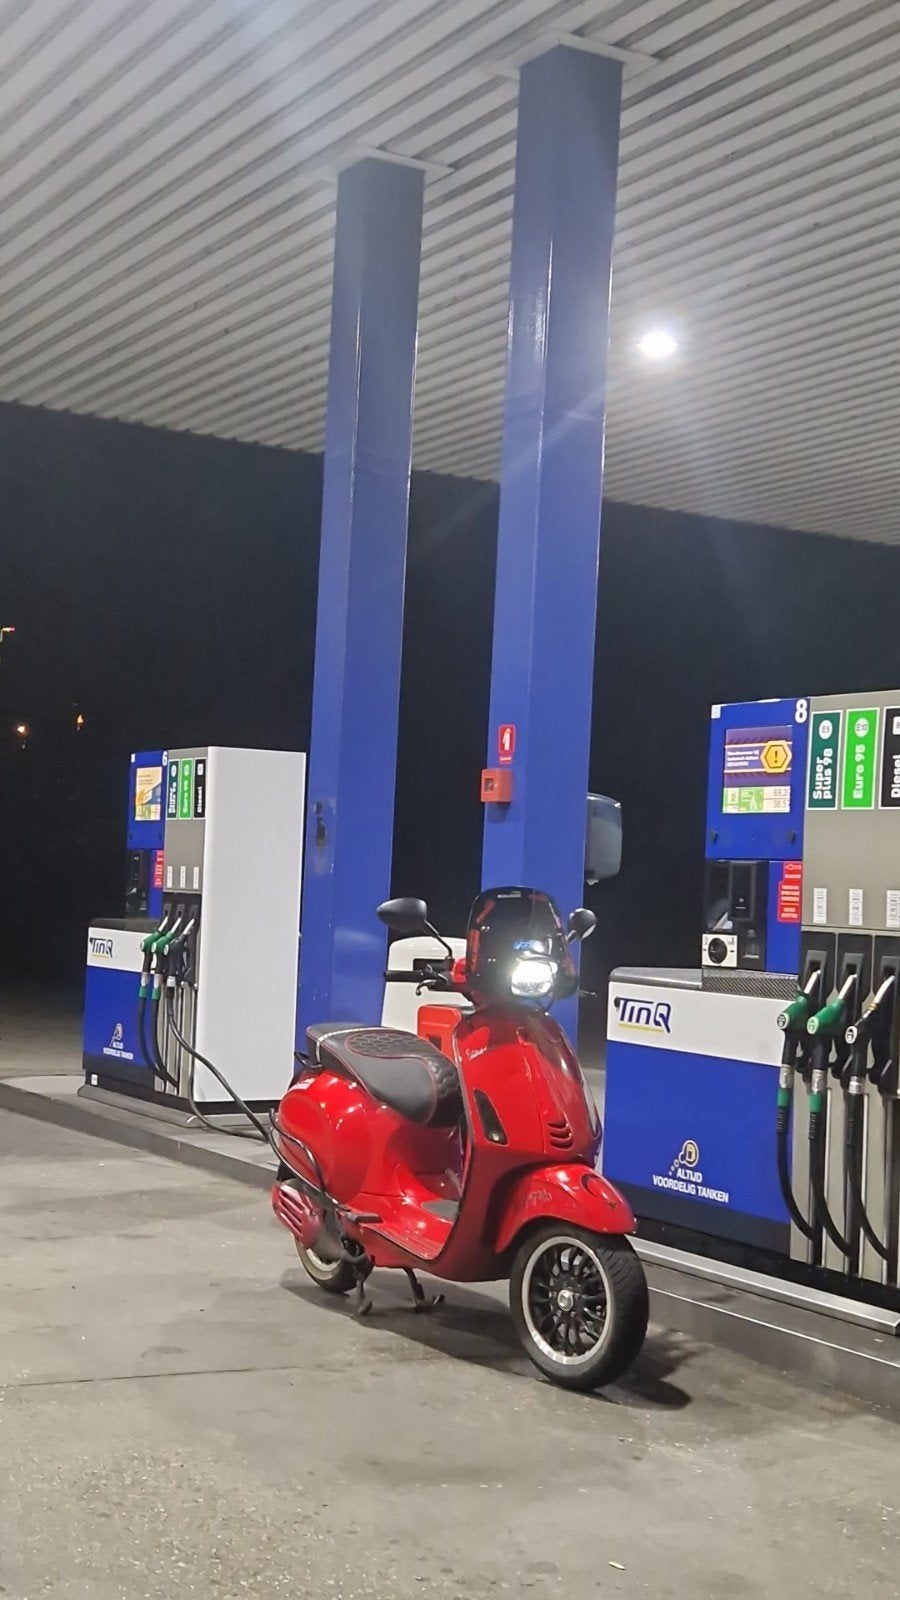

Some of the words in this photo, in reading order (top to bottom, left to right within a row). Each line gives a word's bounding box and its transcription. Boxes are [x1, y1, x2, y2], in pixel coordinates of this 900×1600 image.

[795, 699, 807, 723] 8
[162, 751, 168, 766] 6
[823, 748, 833, 766] 98
[855, 744, 865, 762] 95
[813, 757, 824, 799] Super
[822, 768, 832, 799] plus
[853, 765, 864, 799] Euro
[891, 755, 900, 798] Diesel
[90, 937, 113, 958] TinQ
[614, 997, 671, 1033] TinQ
[677, 1168, 702, 1182] ALTIJD
[653, 1175, 696, 1194] VOORDELIG
[697, 1186, 729, 1203] TANKEN
